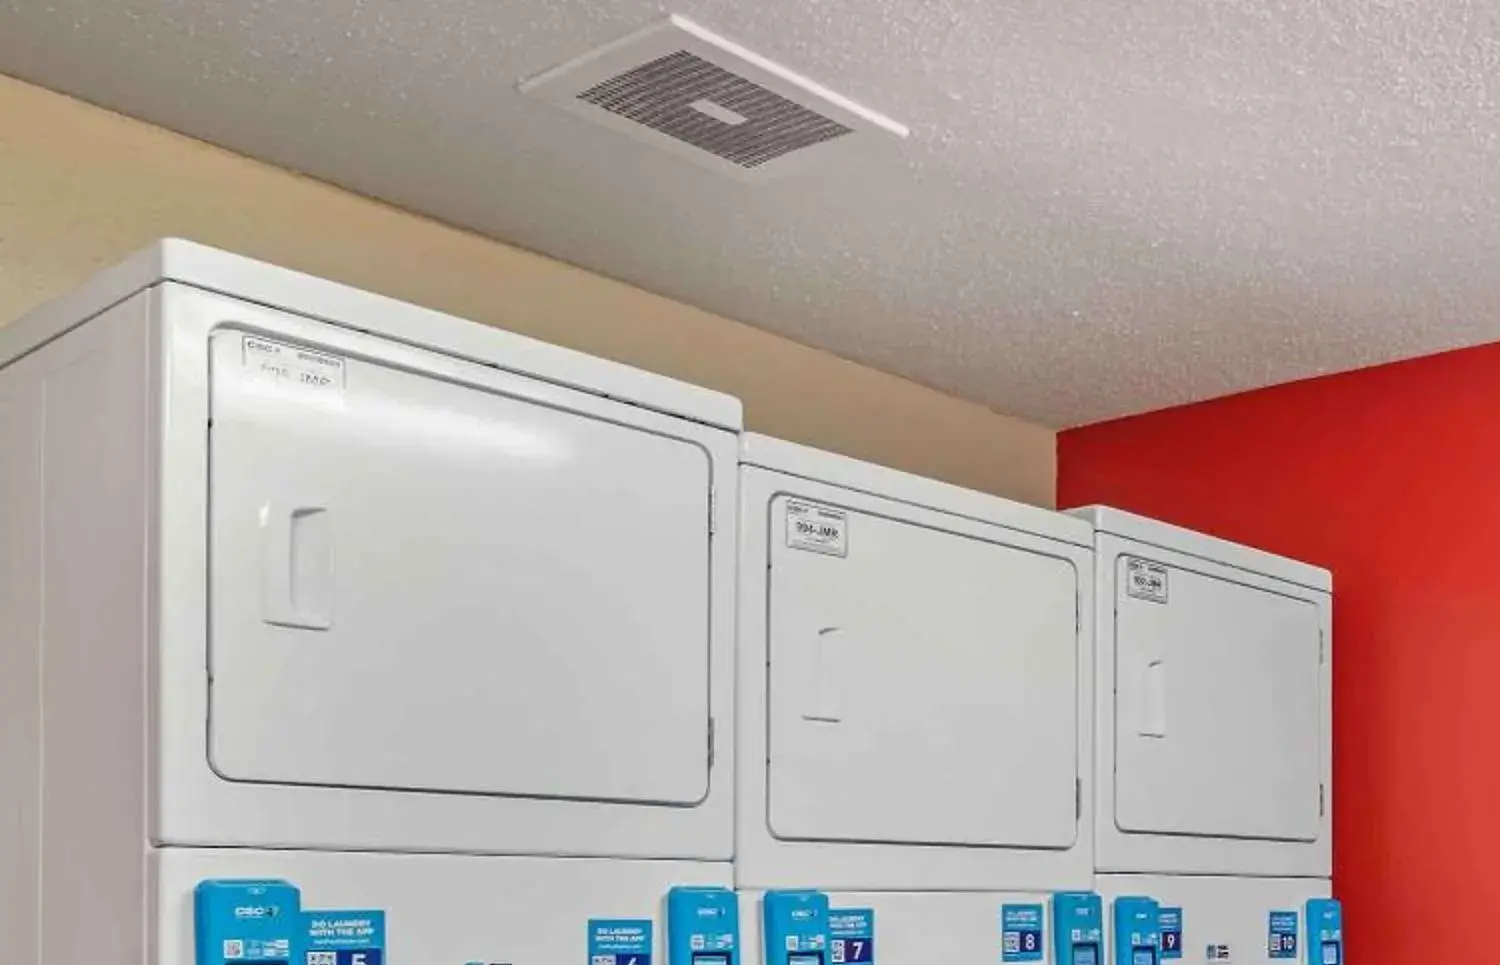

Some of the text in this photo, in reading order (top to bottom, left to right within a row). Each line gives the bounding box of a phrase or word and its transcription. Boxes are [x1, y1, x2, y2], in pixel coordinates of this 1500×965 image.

[1025, 933, 1035, 950] 8
[1167, 934, 1175, 949] 9
[1282, 935, 1295, 950] 10
[852, 941, 864, 960] 7
